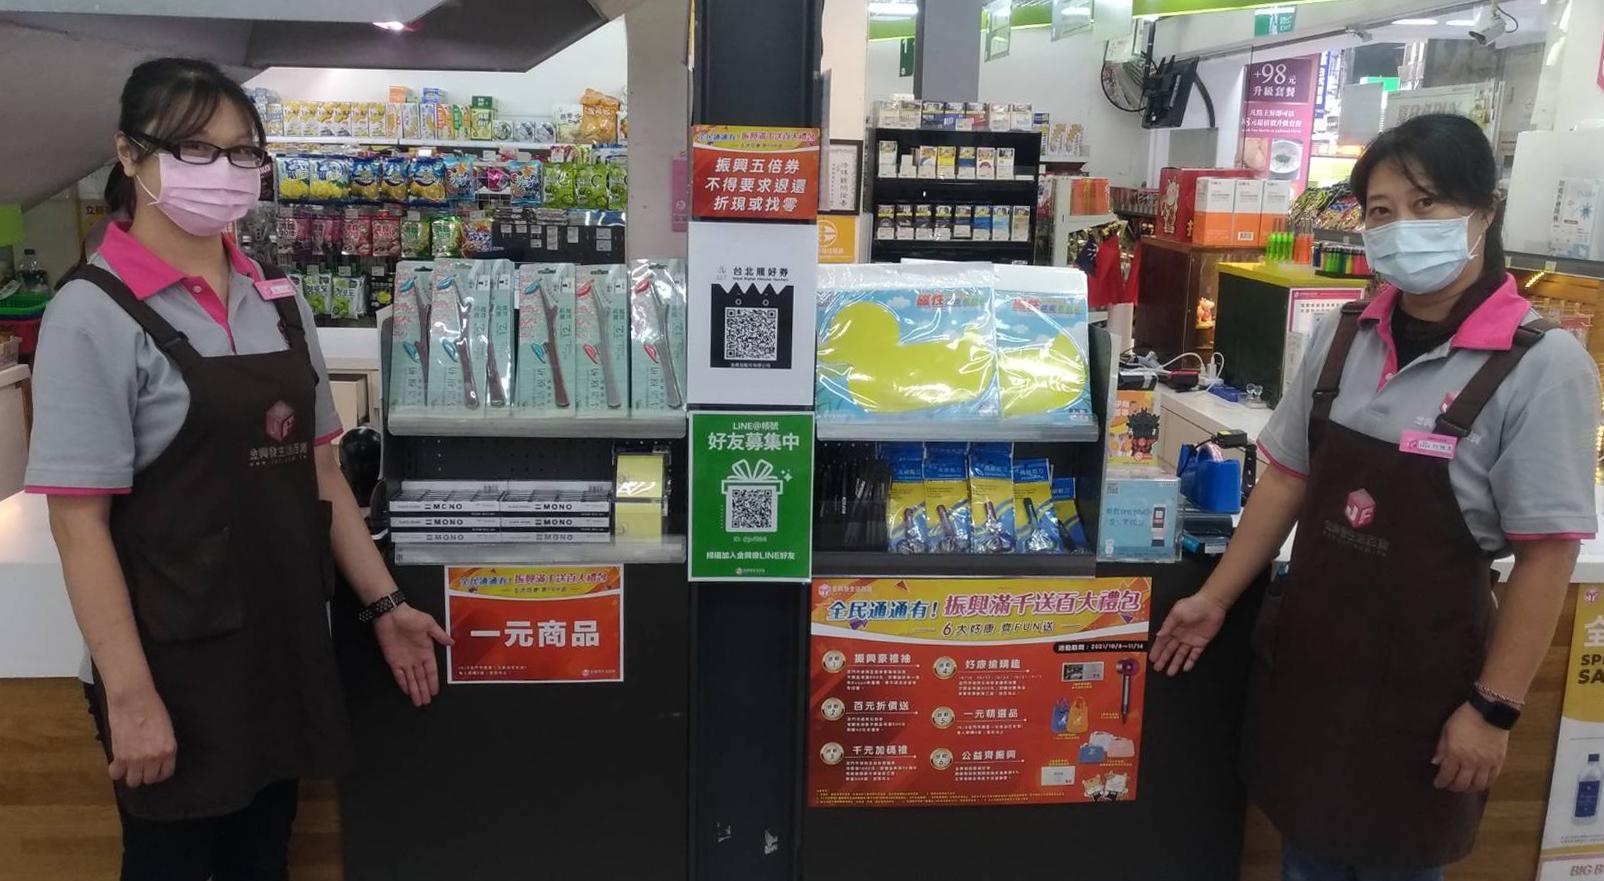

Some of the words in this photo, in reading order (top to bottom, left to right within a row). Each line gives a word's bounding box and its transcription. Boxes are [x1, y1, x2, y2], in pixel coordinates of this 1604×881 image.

[1252, 86, 1296, 98] 升級套餐
[715, 157, 801, 174] 振興五倍券
[705, 177, 806, 194] 不得要求退還
[713, 195, 798, 212] 折現或找零
[708, 432, 800, 451] 好友募集中
[433, 502, 463, 510] MONO
[543, 502, 573, 510] MONO
[434, 518, 464, 526] MONO
[543, 518, 573, 526] MONO
[827, 599, 940, 622] 全民通通有!
[943, 590, 1143, 618] 振興滿千送百大禮包
[470, 619, 600, 648] 一元商品
[854, 653, 912, 664] 振興豪禮抽
[1581, 653, 1604, 667] SP
[853, 701, 910, 711] 百元折價送
[963, 708, 1019, 719] 一元精選品
[852, 745, 908, 755] 千元加碼禮
[962, 749, 1017, 761] 公益齊振興
[1570, 864, 1593, 877] BIG
